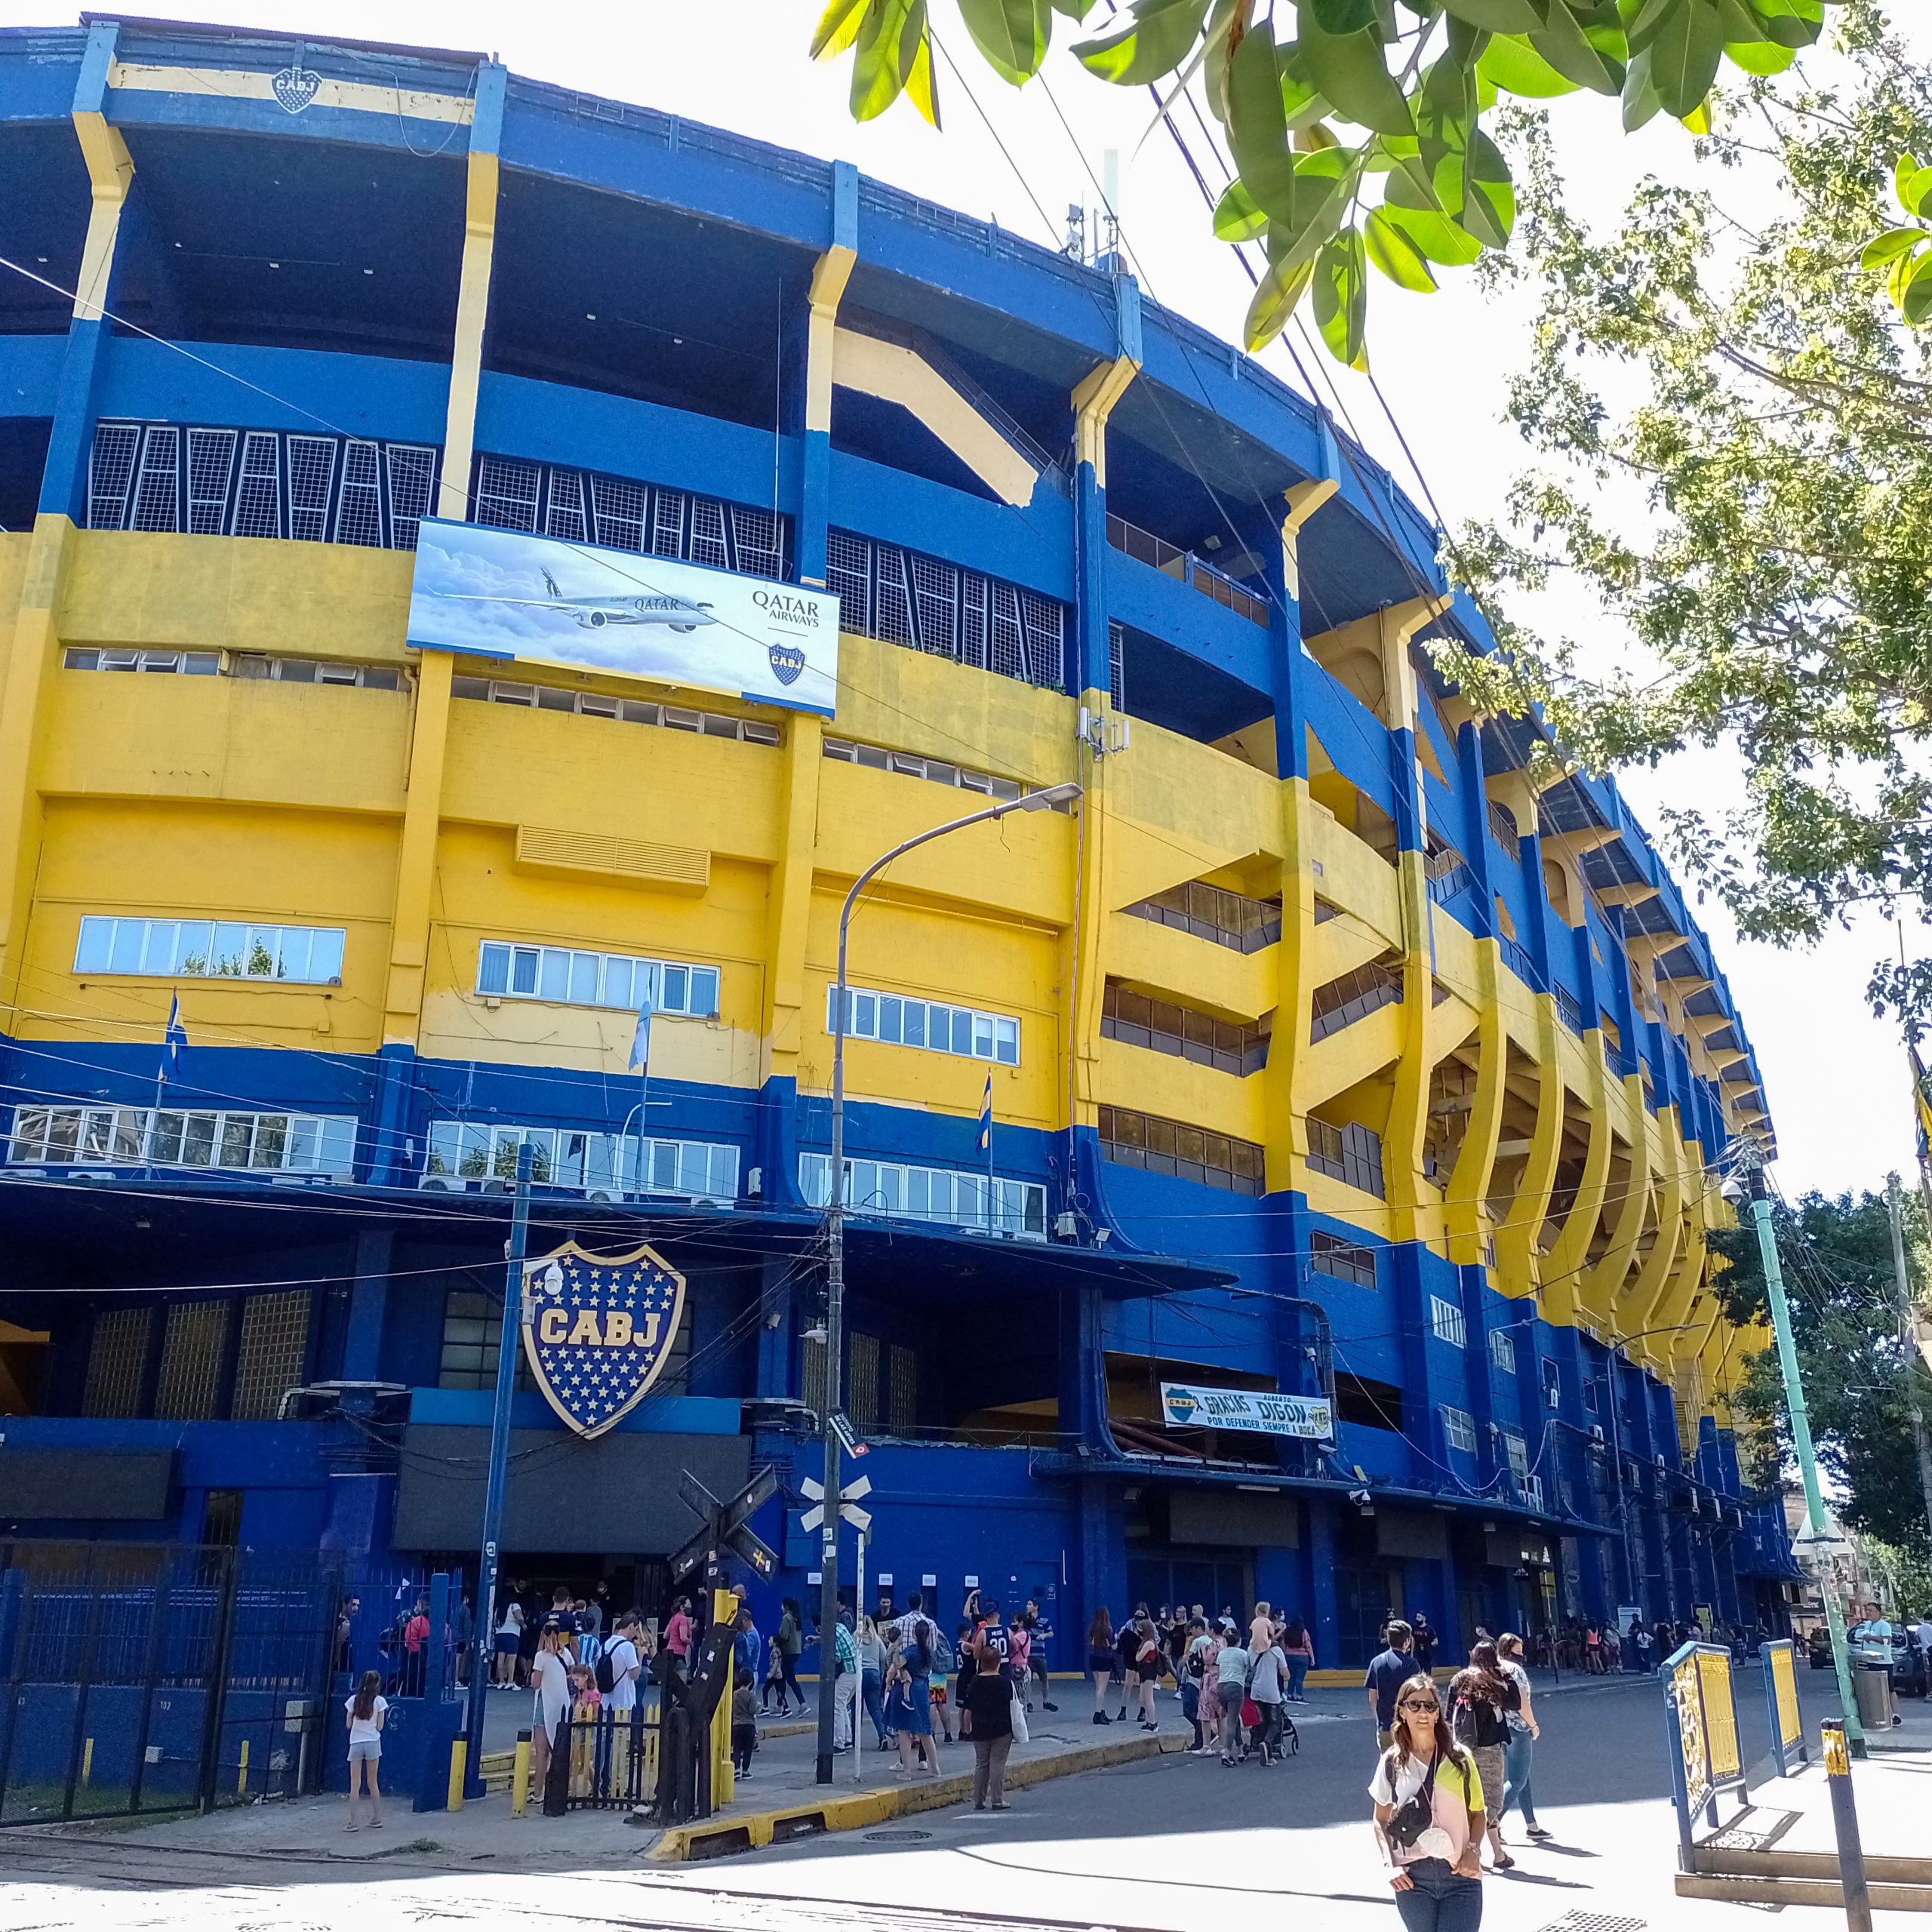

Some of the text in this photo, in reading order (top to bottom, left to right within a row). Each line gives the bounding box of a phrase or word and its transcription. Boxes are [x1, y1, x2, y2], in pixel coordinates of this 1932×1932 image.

[275, 79, 315, 92] CABJ
[635, 598, 679, 612] QATAR
[752, 590, 819, 617] QATAR
[769, 609, 819, 628] AIRWAYS
[771, 655, 802, 669] CABJ
[540, 1308, 661, 1348] CABJ
[1263, 1395, 1291, 1403] ROBERTO
[1204, 1395, 1251, 1415] GRACIAS
[1256, 1401, 1306, 1424] DIGON
[838, 1421, 847, 1430] LAS
[1208, 1417, 1316, 1435] POR DEFENDER SIEMPRE A BOCA
